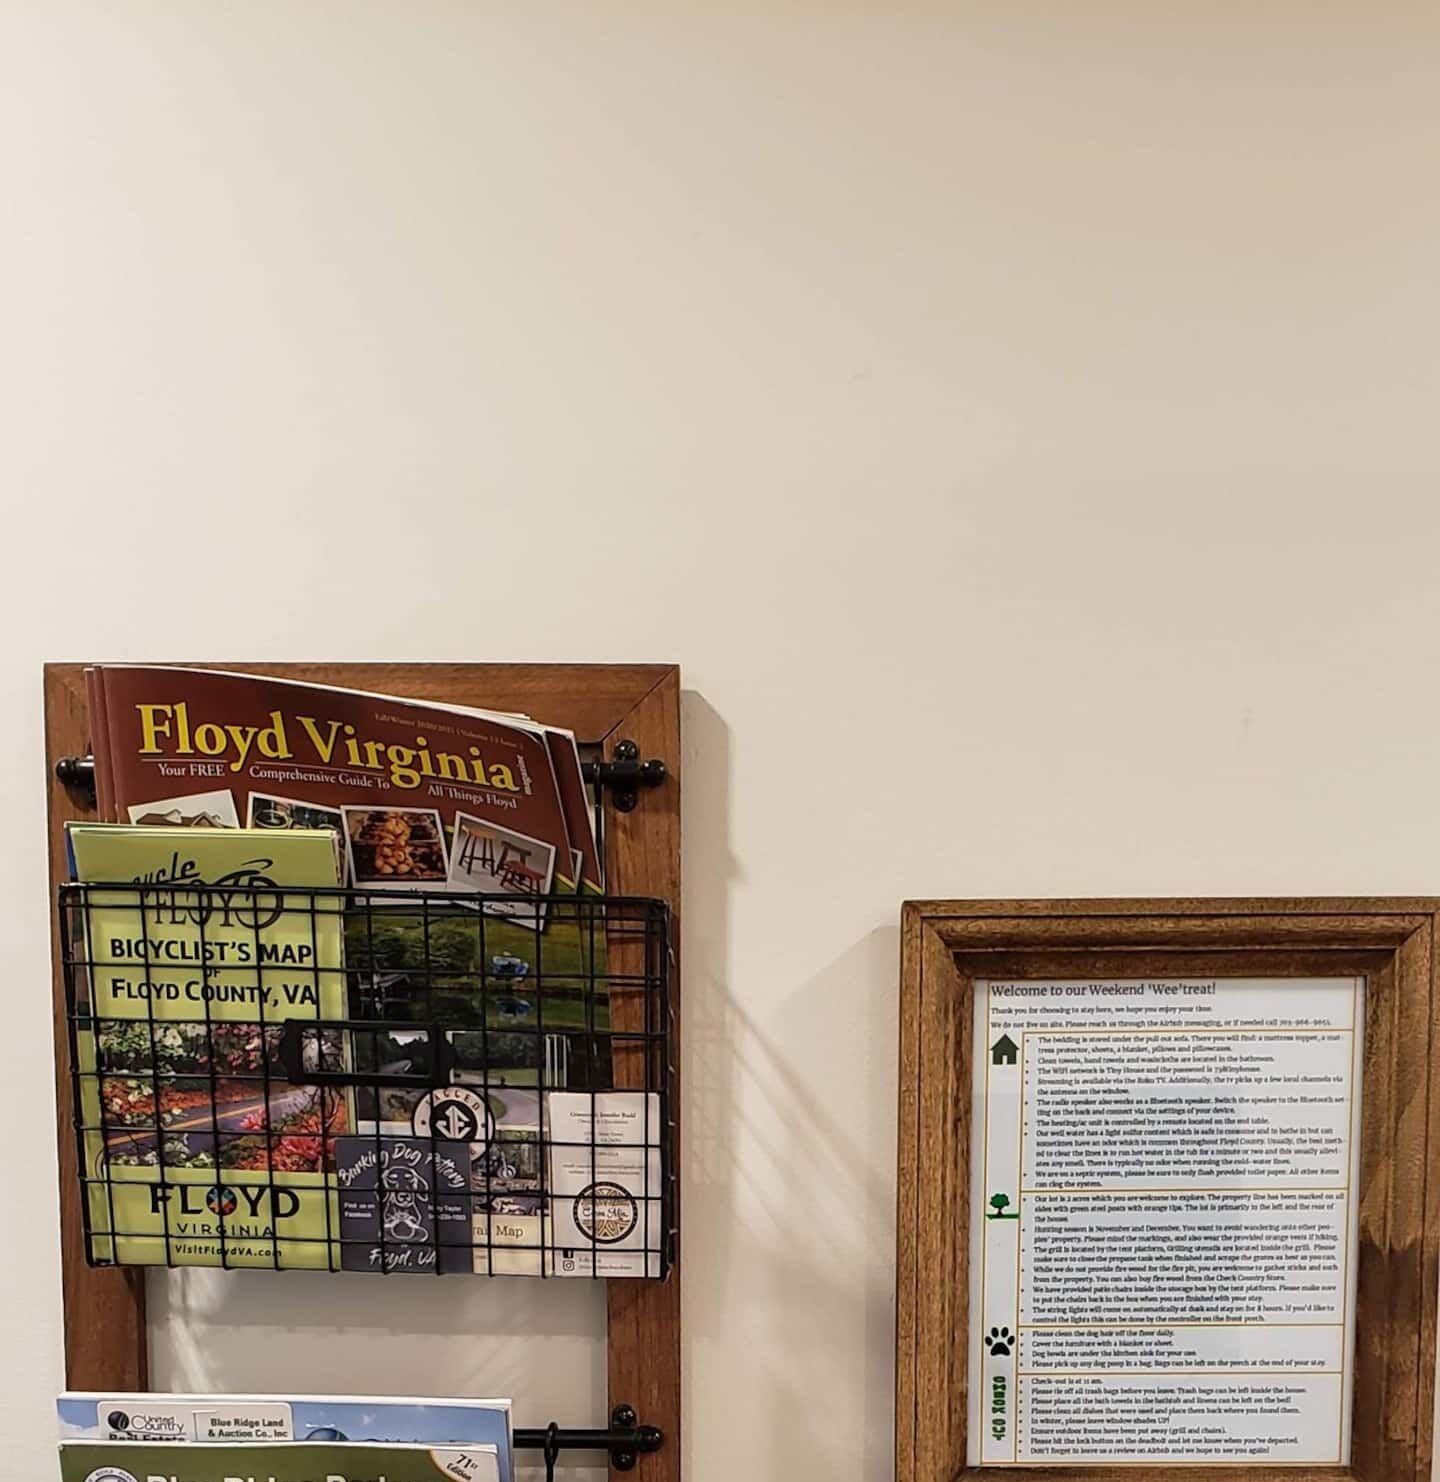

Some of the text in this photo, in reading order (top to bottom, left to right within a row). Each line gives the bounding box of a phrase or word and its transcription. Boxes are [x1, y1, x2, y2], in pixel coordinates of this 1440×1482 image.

[136, 702, 520, 790] Floyd Virginia
[158, 764, 225, 776] Your FREE
[250, 766, 390, 790] Comprehensive Guide To
[428, 785, 518, 810] All Things Floyd
[258, 944, 312, 964] MAP
[111, 978, 316, 1007] FLOYD COUNTY, VA
[990, 985, 1048, 996] Welcome
[1049, 985, 1062, 996] to
[1065, 987, 1086, 995] our
[1088, 984, 1144, 995] Weekend
[1039, 1006, 1071, 1015] choosing
[1080, 1006, 1094, 1015] stay
[1125, 1005, 1143, 1015] hope
[1117, 1020, 1145, 1029] through
[392, 1143, 422, 1166] Dog
[1048, 1180, 1063, 1189] clog
[150, 1184, 300, 1218] FLOYD
[176, 1223, 274, 1238] VIRGINIA
[496, 1226, 524, 1239] Map
[1085, 1329, 1098, 1339] dog
[131, 1414, 184, 1432] Country
[144, 1414, 175, 1424] United
[210, 1418, 284, 1430] Blue Ridge Land
[1064, 1416, 1085, 1426] please
[208, 1430, 216, 1438] &
[218, 1430, 254, 1438] Auction
[274, 1430, 288, 1438] Inc
[446, 1464, 473, 1482] Edition
